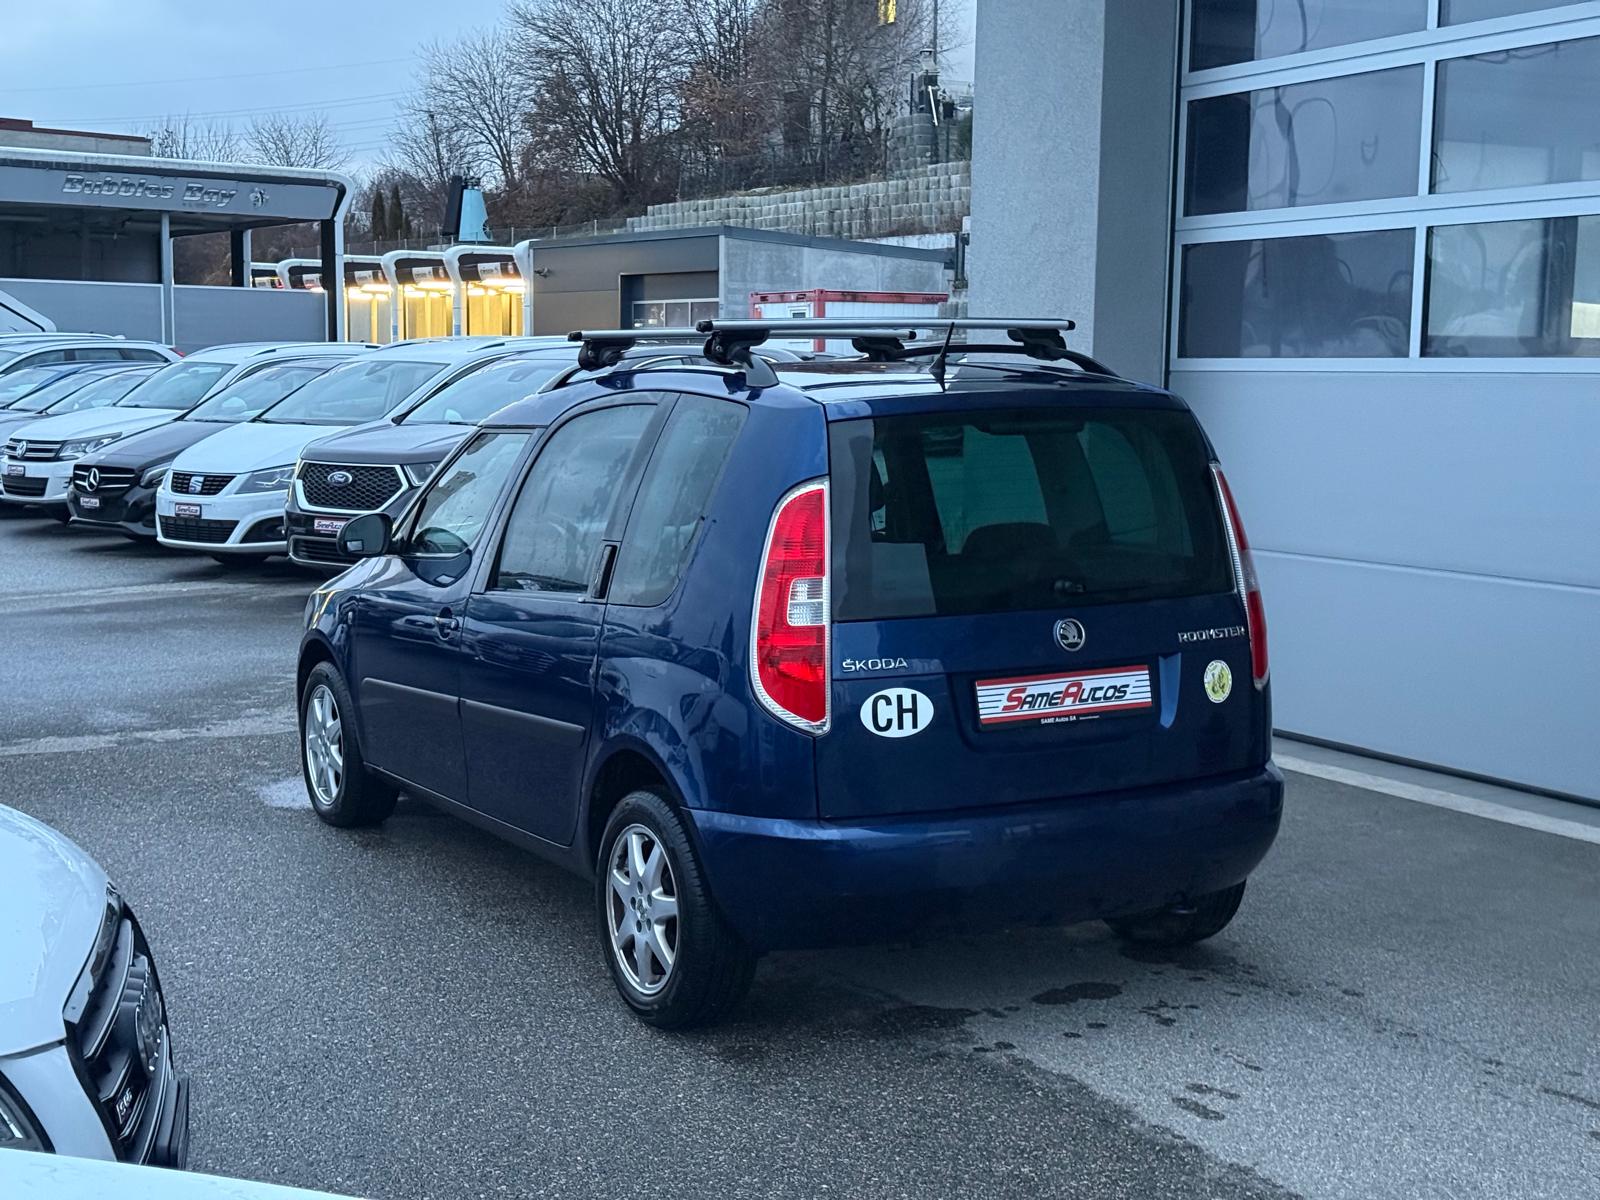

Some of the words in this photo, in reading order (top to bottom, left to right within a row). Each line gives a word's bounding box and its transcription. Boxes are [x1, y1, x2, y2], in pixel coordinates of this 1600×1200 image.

[62, 174, 175, 199] Bubbles
[183, 183, 238, 207] Bay
[1178, 625, 1246, 643] ROOMSTER
[842, 658, 909, 673] ŠKODA
[871, 693, 919, 733] CH
